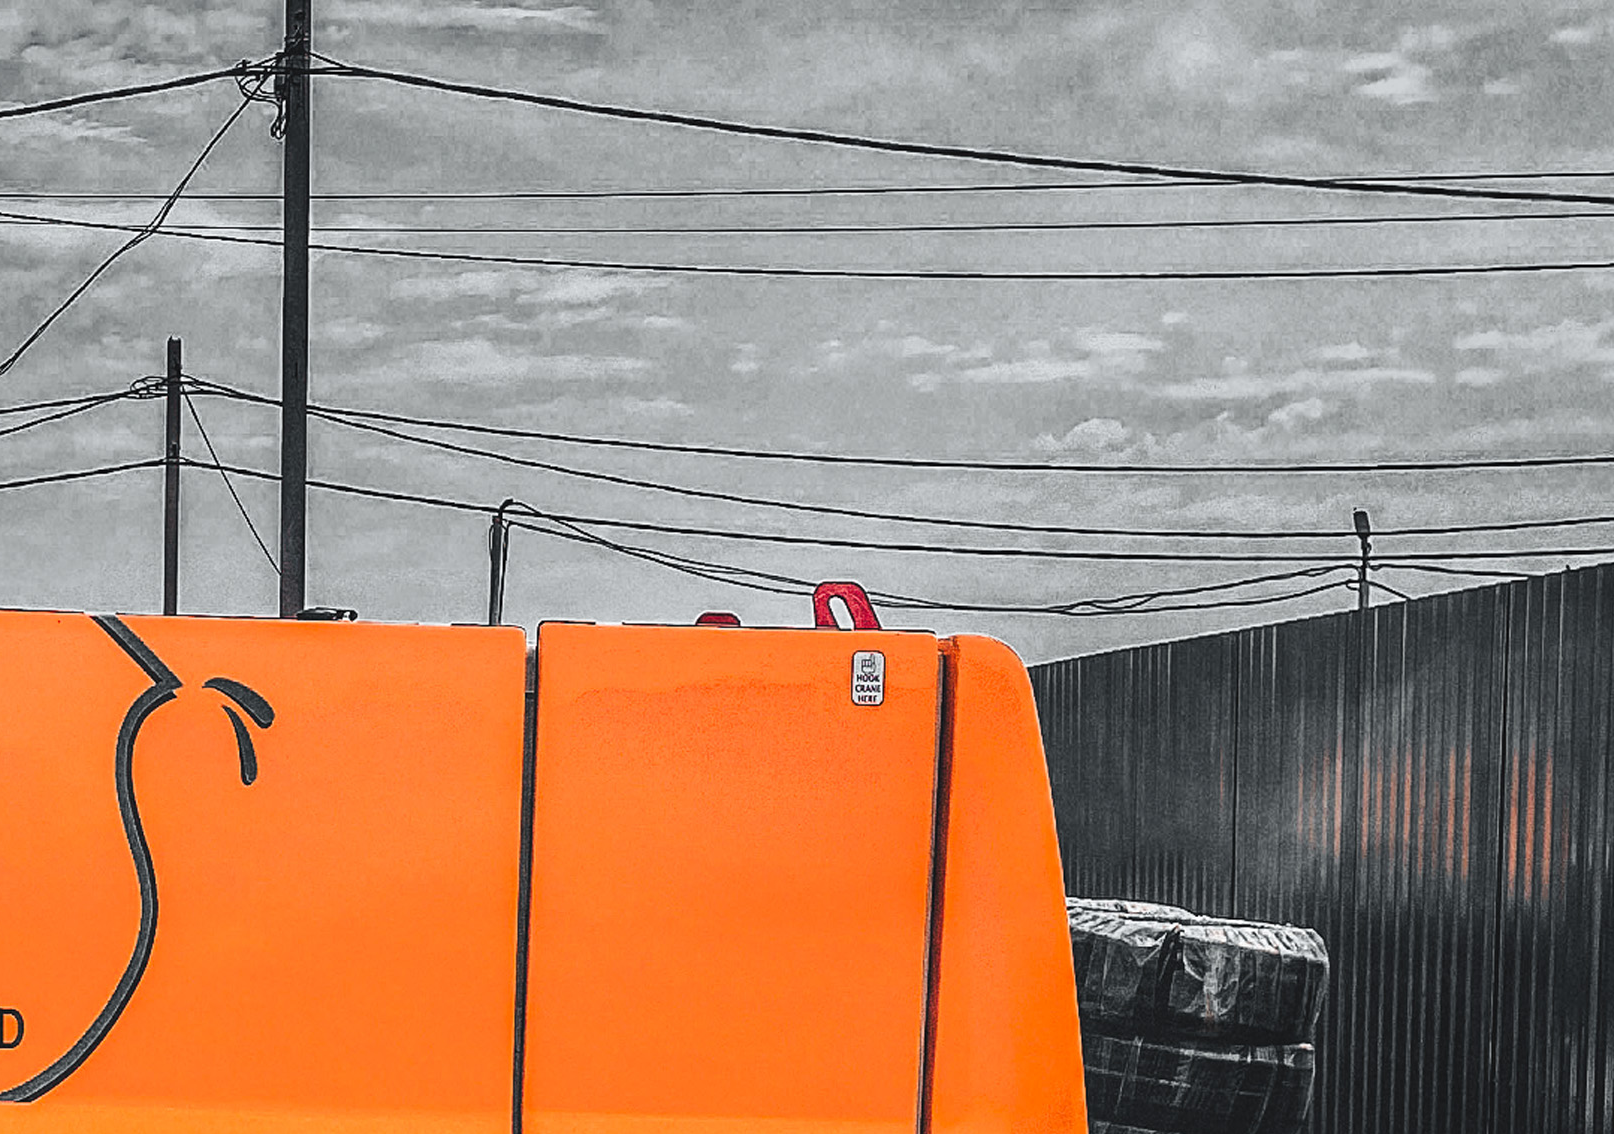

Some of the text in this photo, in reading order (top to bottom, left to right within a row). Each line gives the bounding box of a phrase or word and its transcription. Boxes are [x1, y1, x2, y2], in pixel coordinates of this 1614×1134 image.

[856, 674, 880, 683] HOOK
[855, 684, 881, 693] CRANE
[857, 695, 878, 703] HERE
